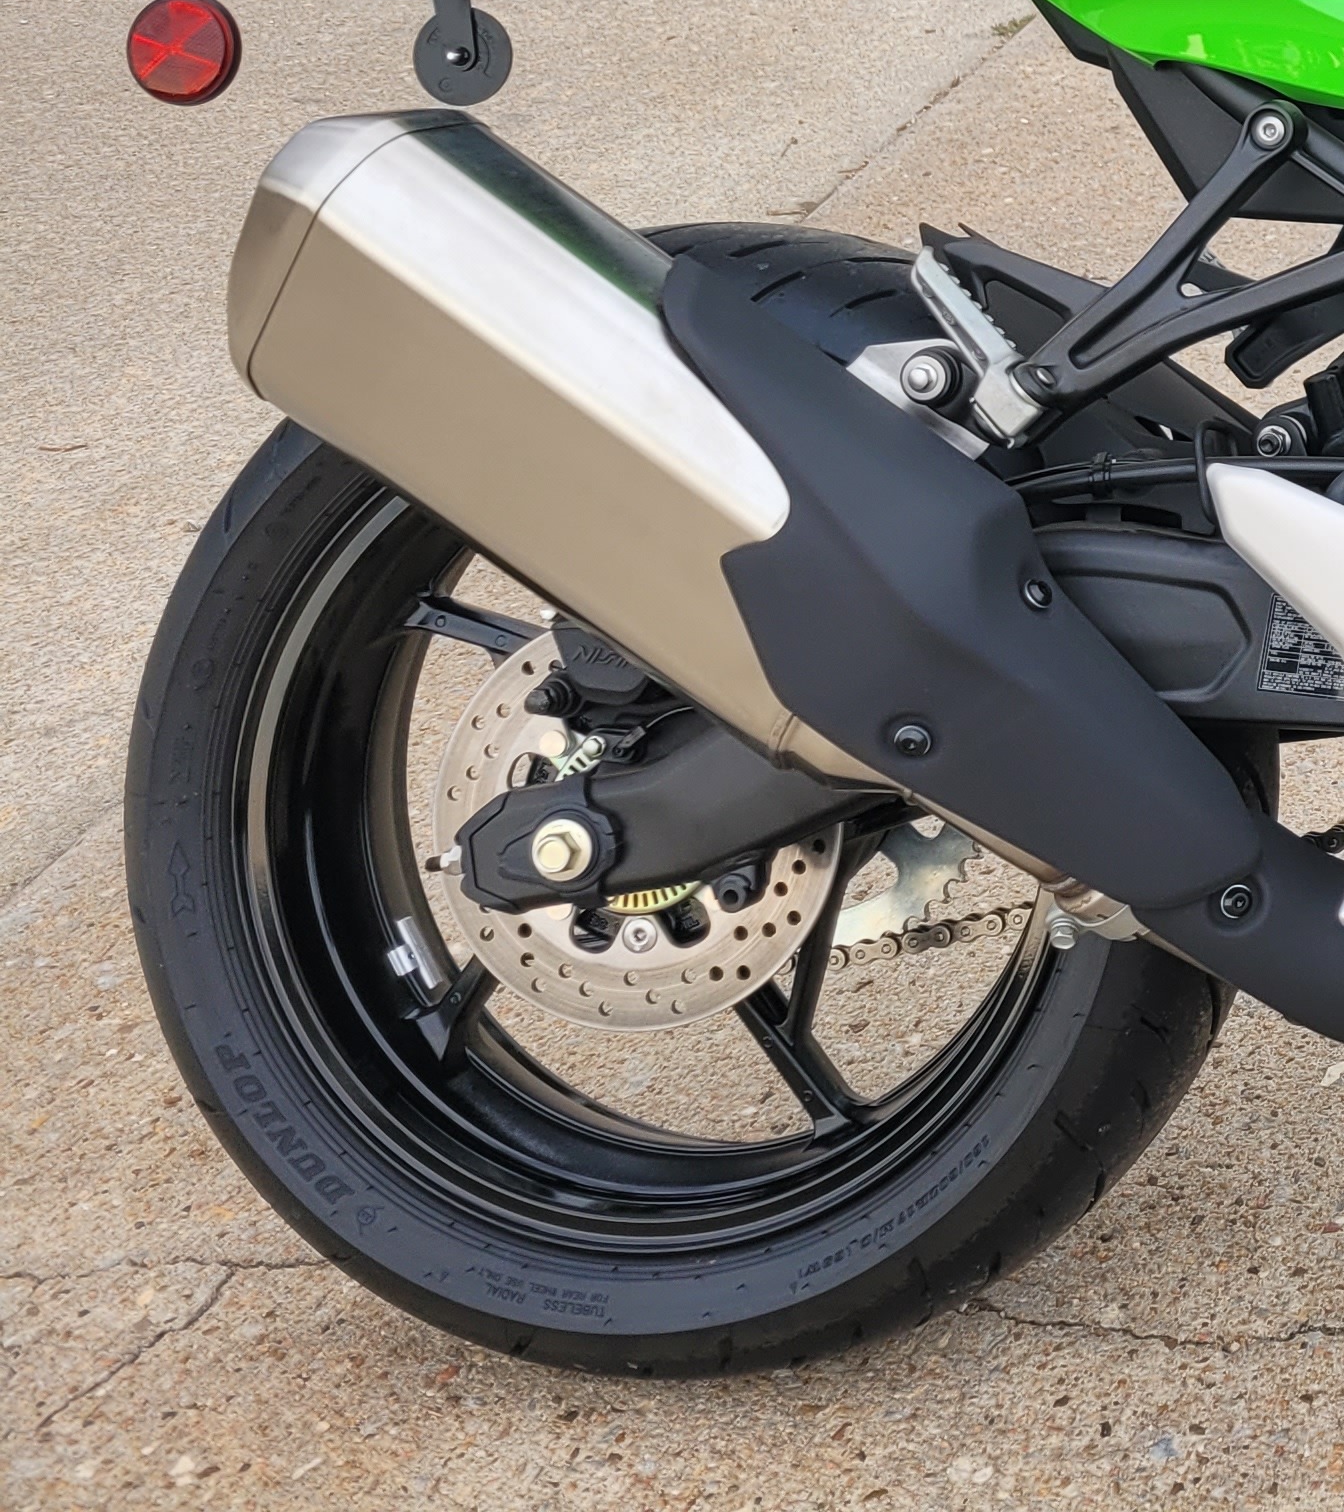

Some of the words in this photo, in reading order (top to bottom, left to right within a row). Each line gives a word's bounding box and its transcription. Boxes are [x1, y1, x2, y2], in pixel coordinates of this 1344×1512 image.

[213, 1043, 356, 1207] DUNLOP
[483, 1281, 527, 1305] RADIAL
[542, 1297, 606, 1320] TUBELESS
